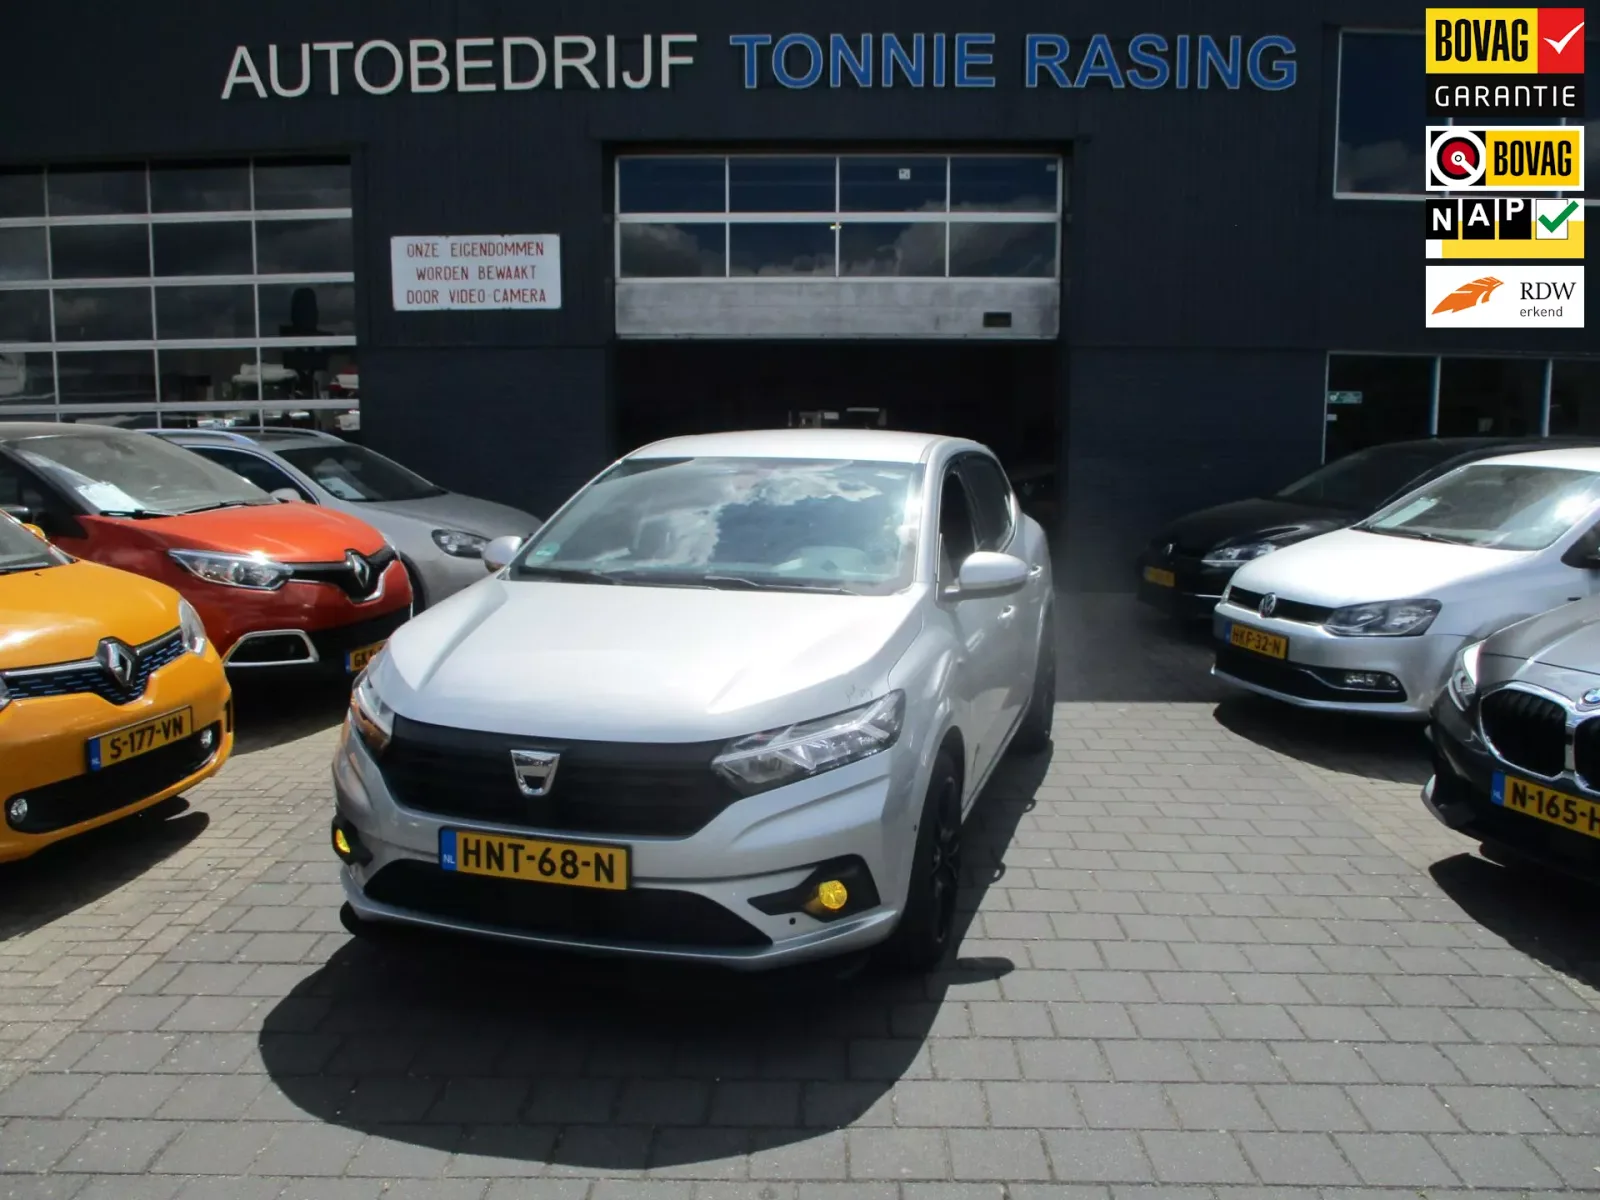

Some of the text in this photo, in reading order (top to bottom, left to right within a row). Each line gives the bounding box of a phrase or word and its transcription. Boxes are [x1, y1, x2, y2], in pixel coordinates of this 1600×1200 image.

[221, 33, 1298, 99] AUTOBEDRIJF TONNIE RASING
[406, 241, 545, 258] ONZE EIGENDOMMEN
[415, 265, 537, 281] WORDEN BEWAAKT
[406, 289, 440, 304] DOOR
[109, 714, 184, 760] S-177-VN
[443, 853, 456, 865] NL
[462, 837, 615, 883] HNT-68-N
